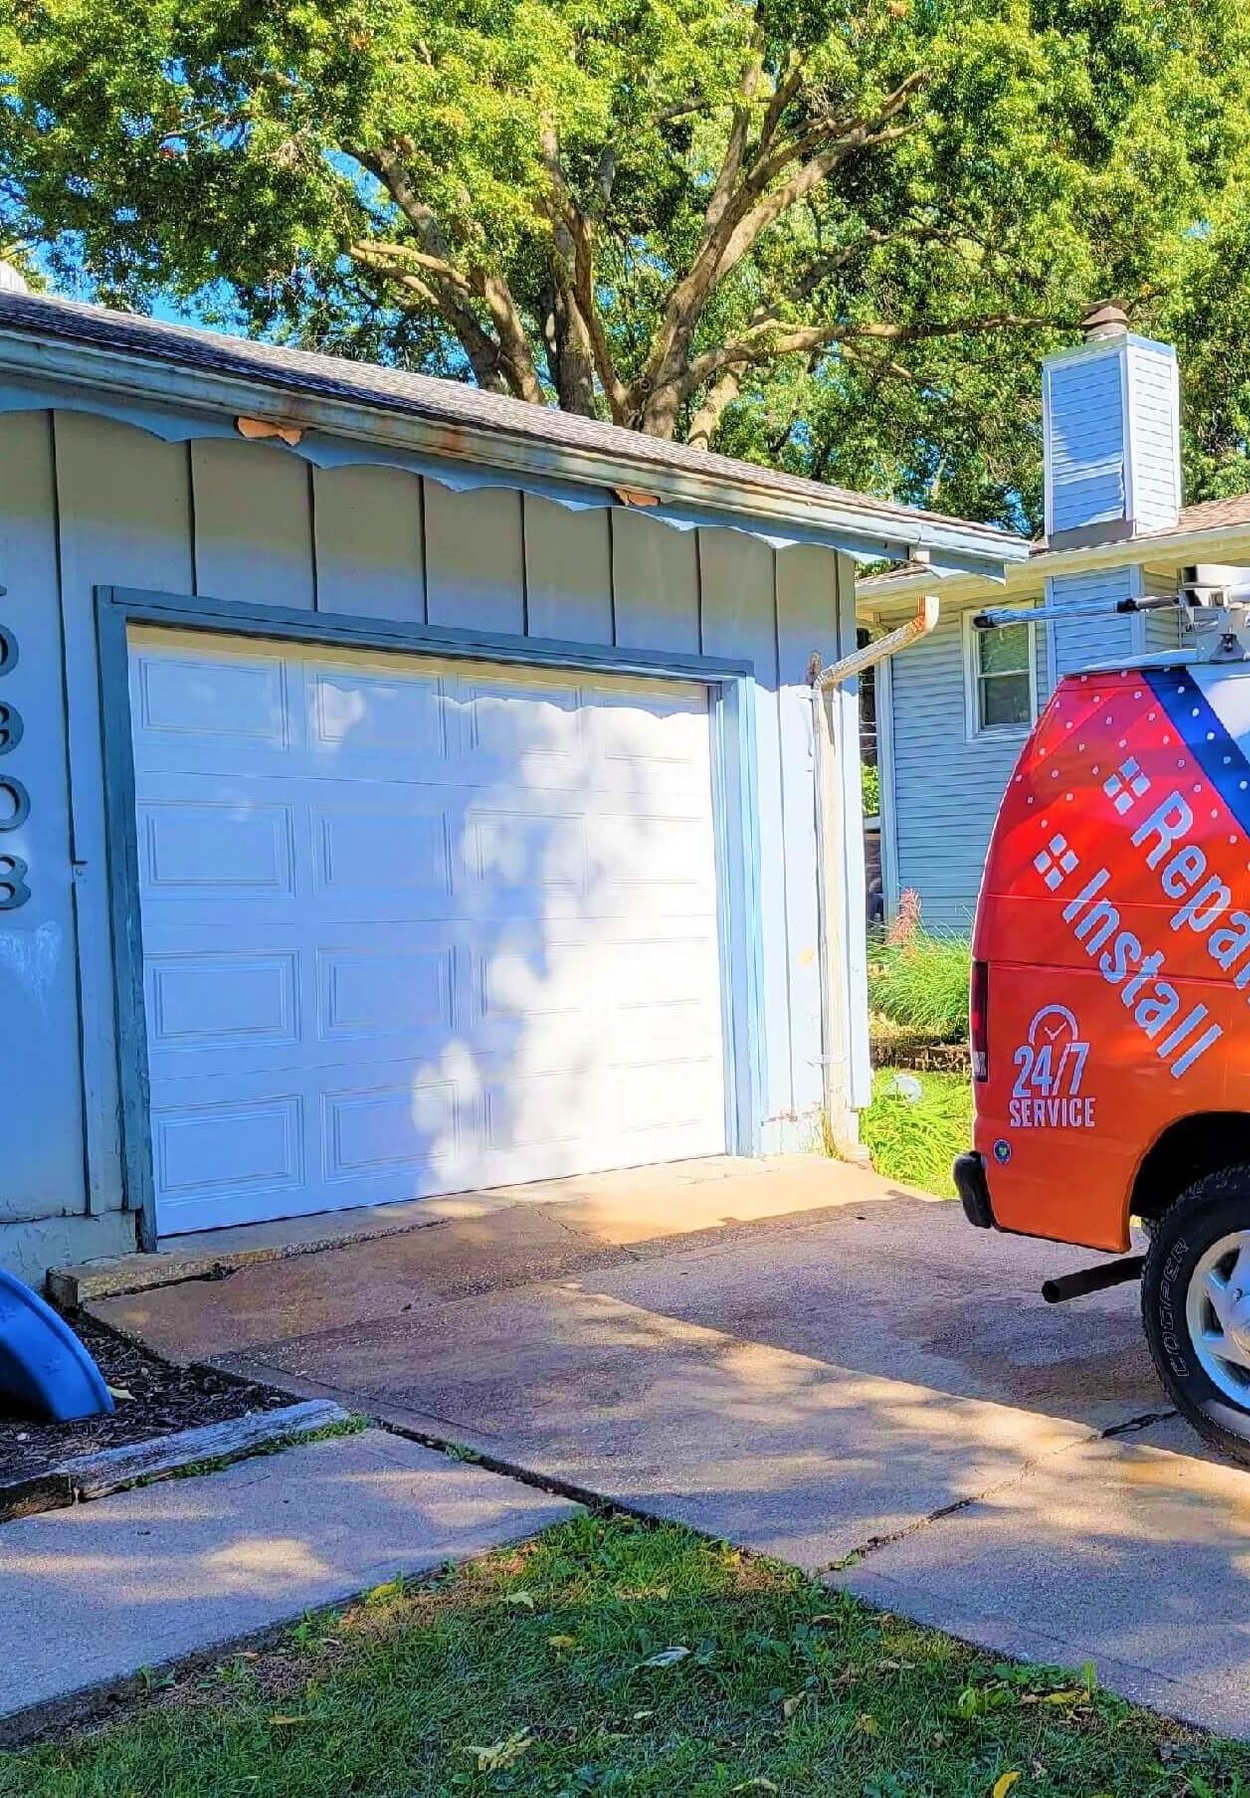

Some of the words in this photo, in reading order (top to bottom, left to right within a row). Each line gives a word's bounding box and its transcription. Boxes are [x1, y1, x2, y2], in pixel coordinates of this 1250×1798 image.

[1061, 867, 1223, 1079] Install
[1009, 1097, 1097, 1128] SERVICE
[1012, 1042, 1090, 1099] 24/7
[1158, 1236, 1190, 1378] COOPER
